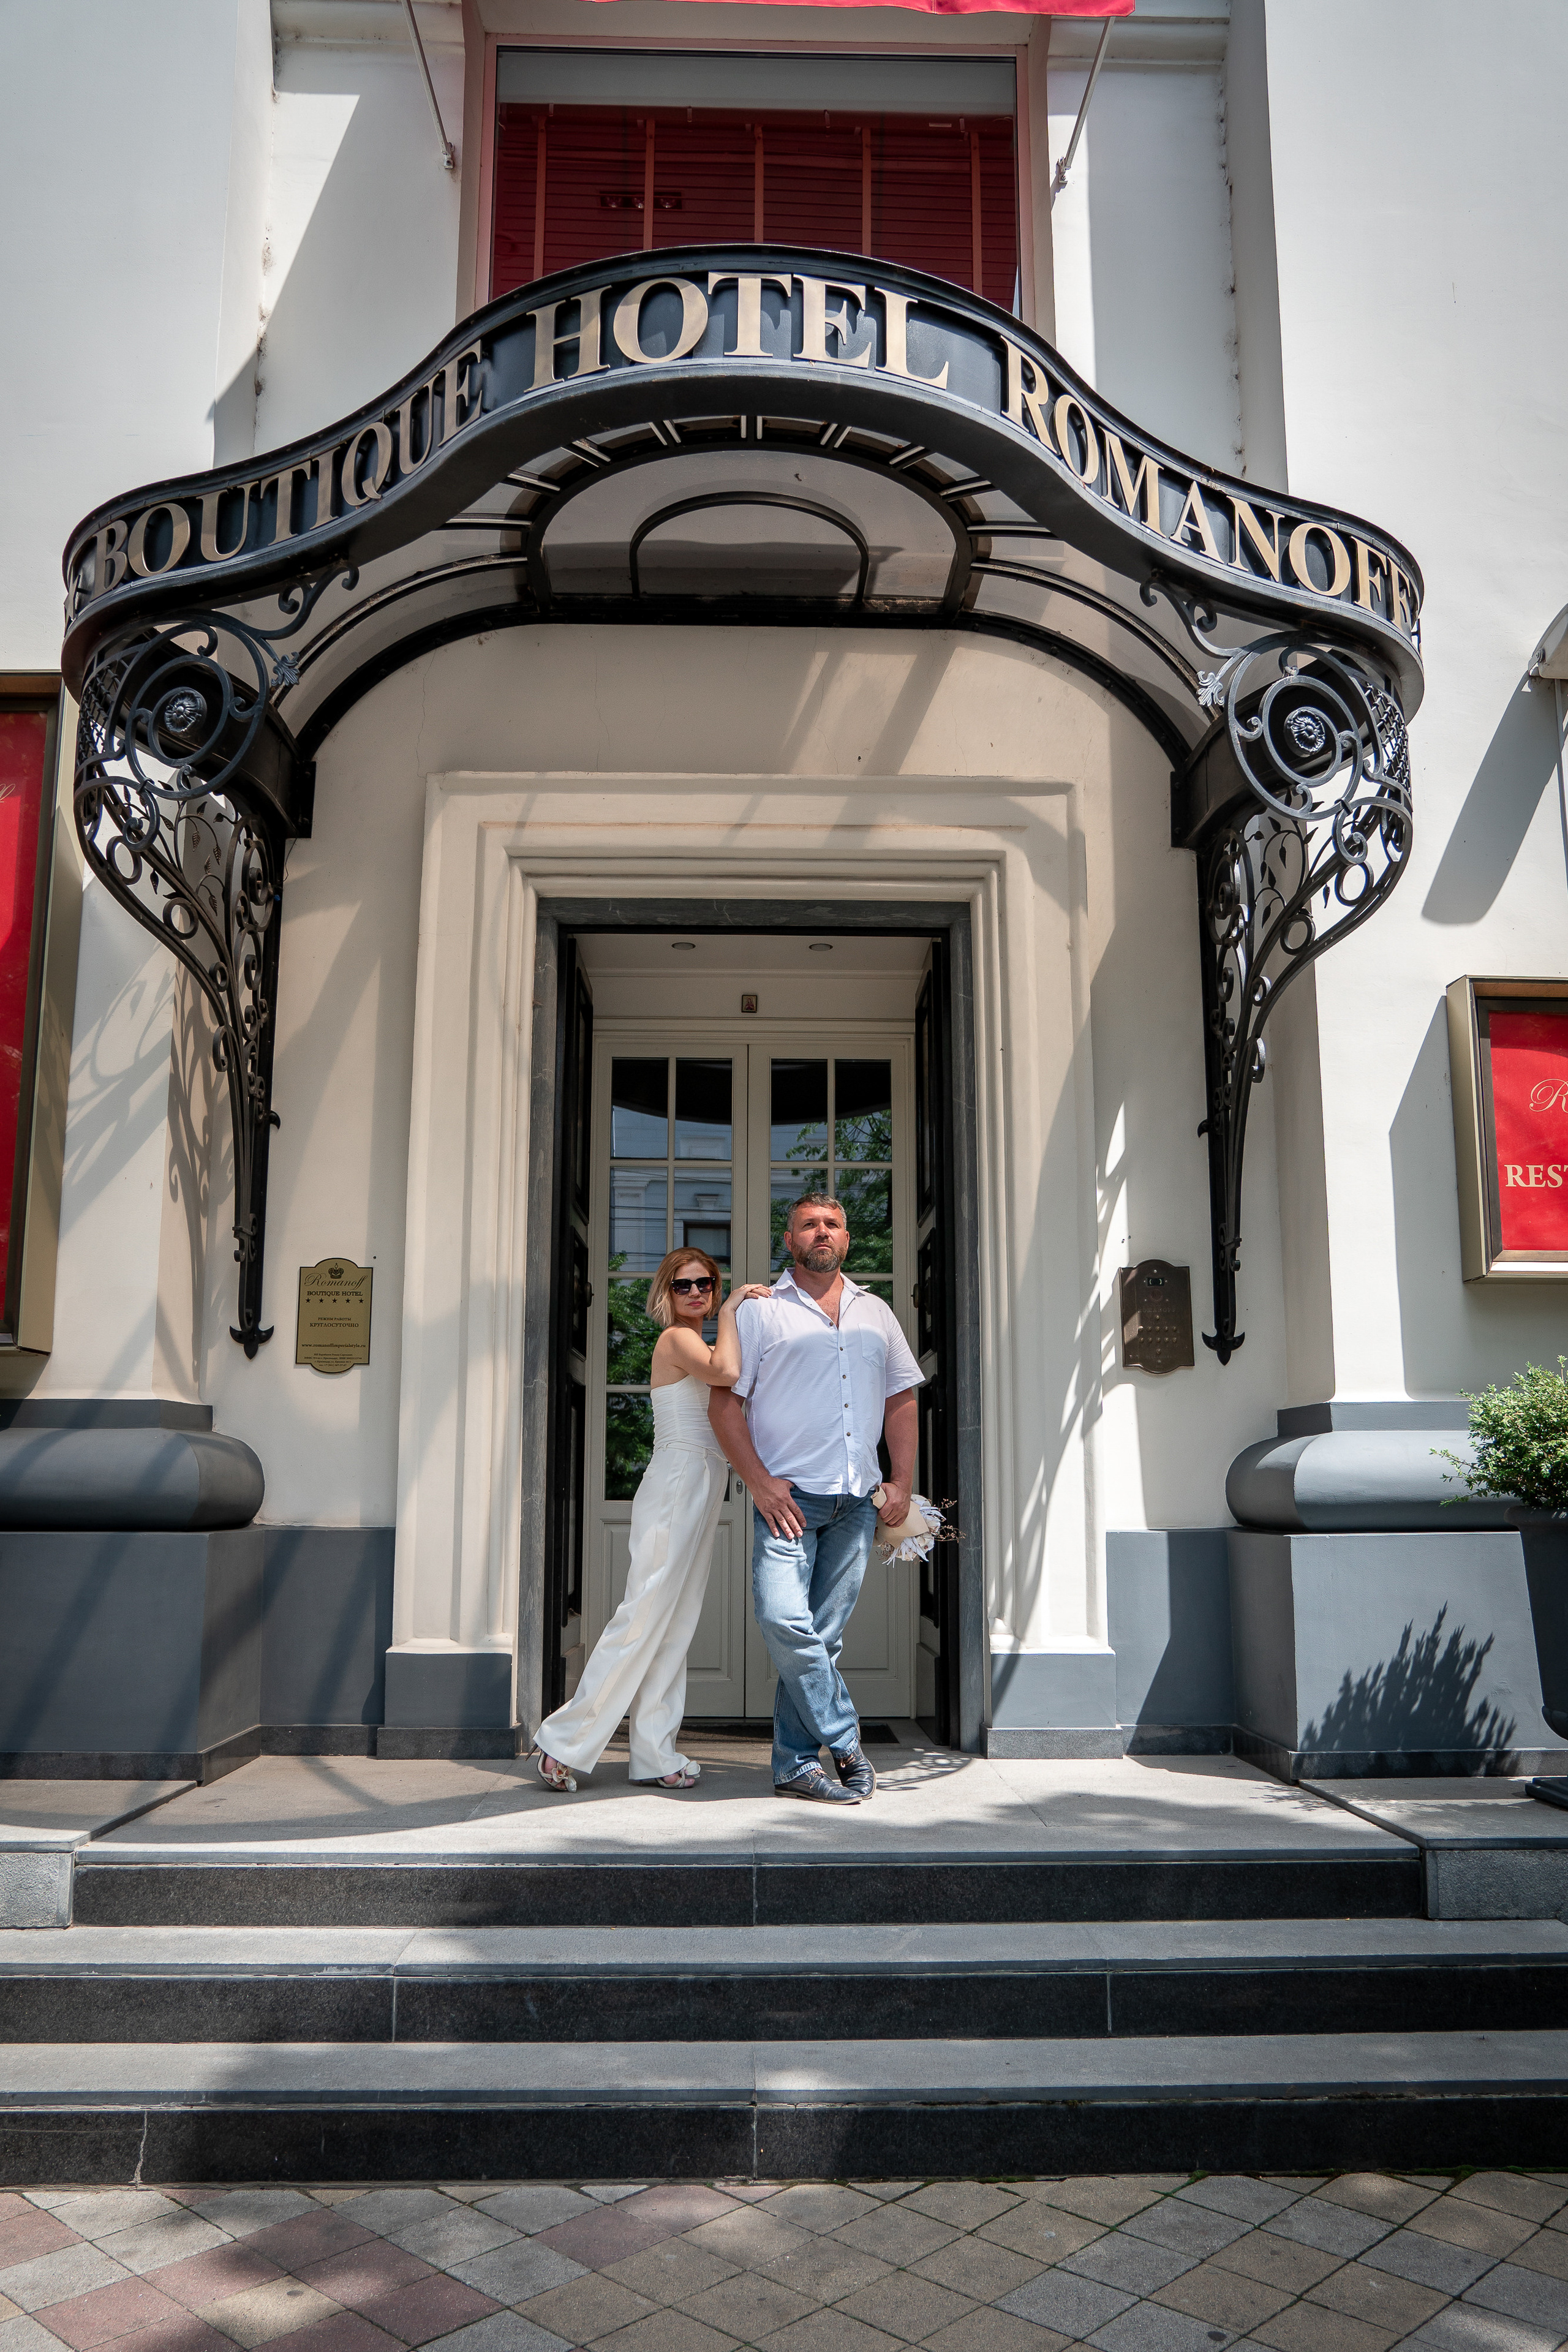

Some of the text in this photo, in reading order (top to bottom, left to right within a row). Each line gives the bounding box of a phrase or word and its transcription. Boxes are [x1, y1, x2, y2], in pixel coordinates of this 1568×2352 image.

[90, 272, 1419, 630] BOUTIQUE HOTEL ROMANOFF
[304, 1273, 368, 1290] Romanoff
